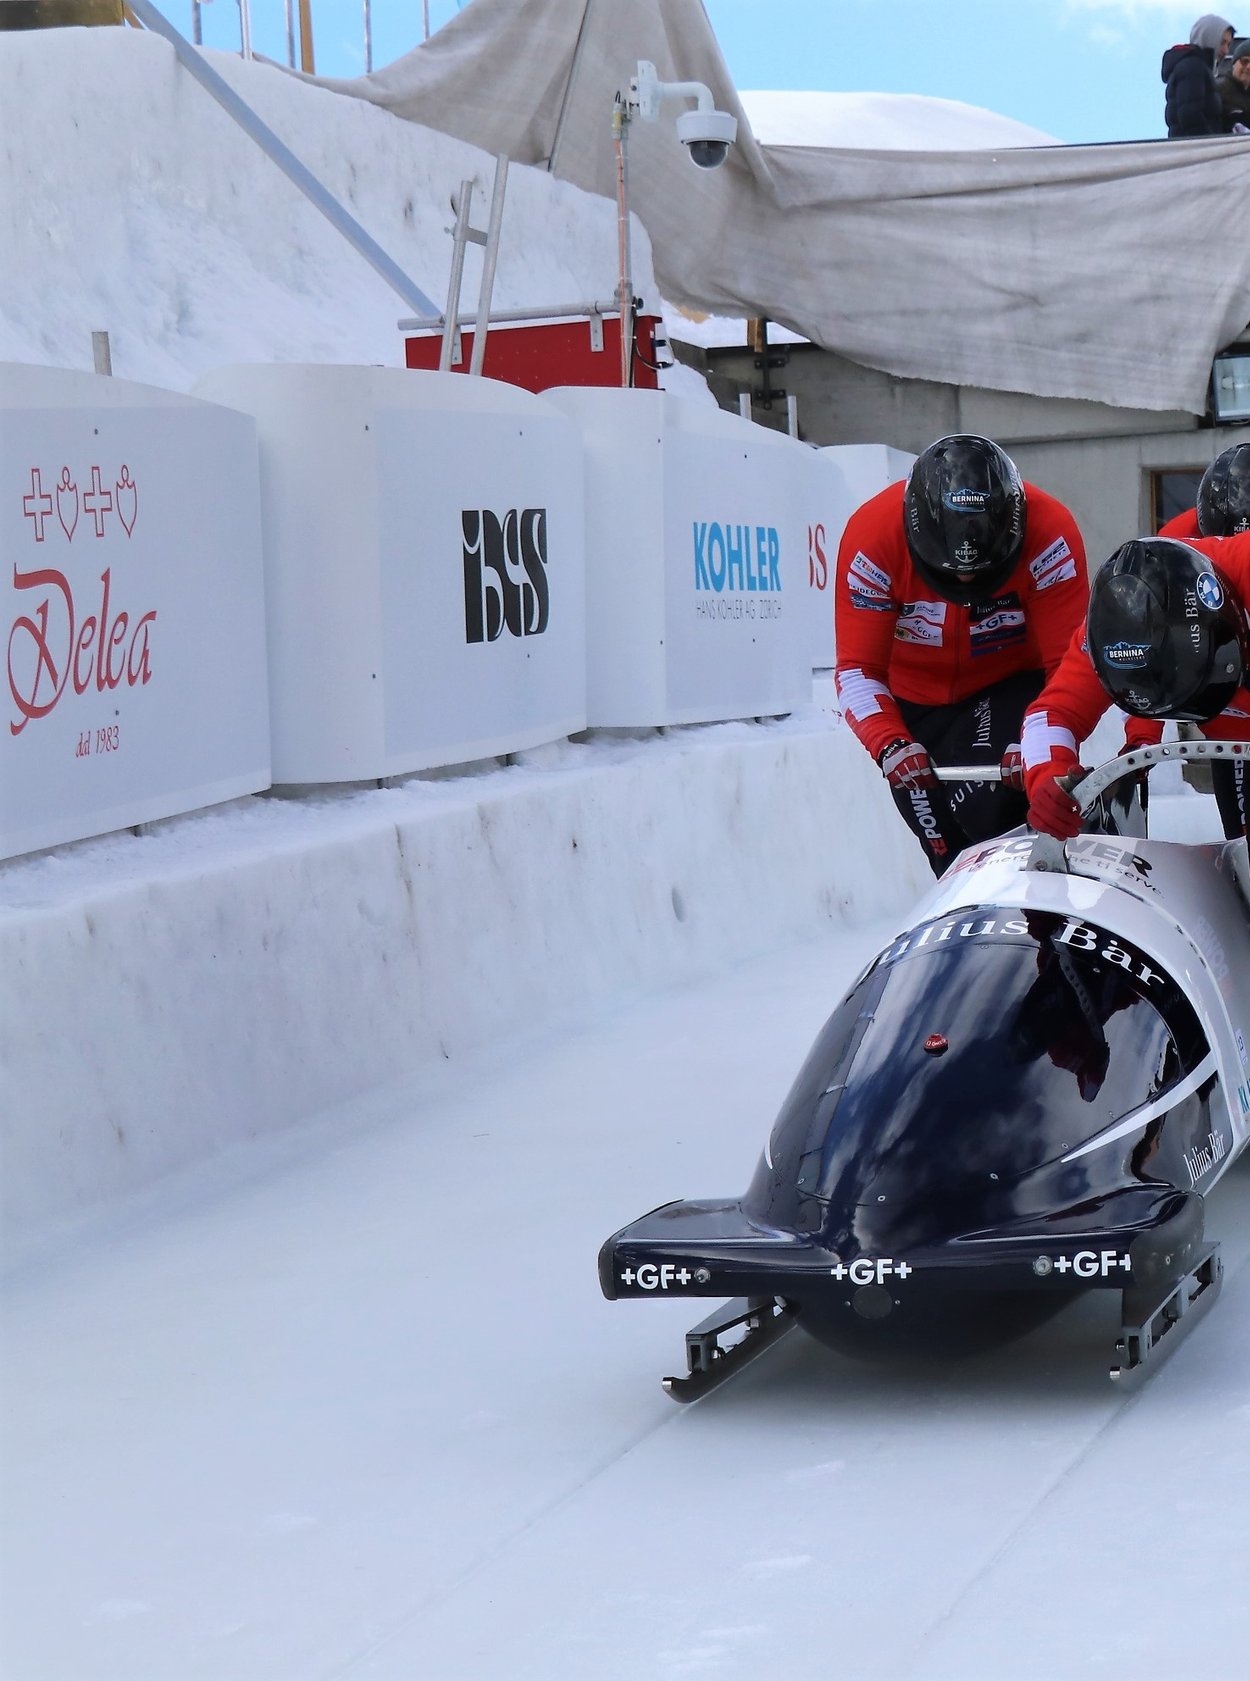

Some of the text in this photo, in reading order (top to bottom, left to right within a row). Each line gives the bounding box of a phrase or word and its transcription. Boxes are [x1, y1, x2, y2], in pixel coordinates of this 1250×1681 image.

[952, 495, 985, 503] BERNINA
[693, 521, 783, 593] KOHLER
[697, 599, 717, 620] HANS
[718, 599, 744, 620] KOHLER
[746, 599, 756, 620] AG
[1184, 588, 1199, 618] Bär
[1109, 649, 1145, 659] BERNINA
[96, 725, 120, 754] 1983
[878, 918, 1165, 988] ulius Bär
[1183, 1129, 1226, 1186] Julius Bär
[620, 1263, 692, 1290] +GF+
[830, 1258, 913, 1286] +GF+
